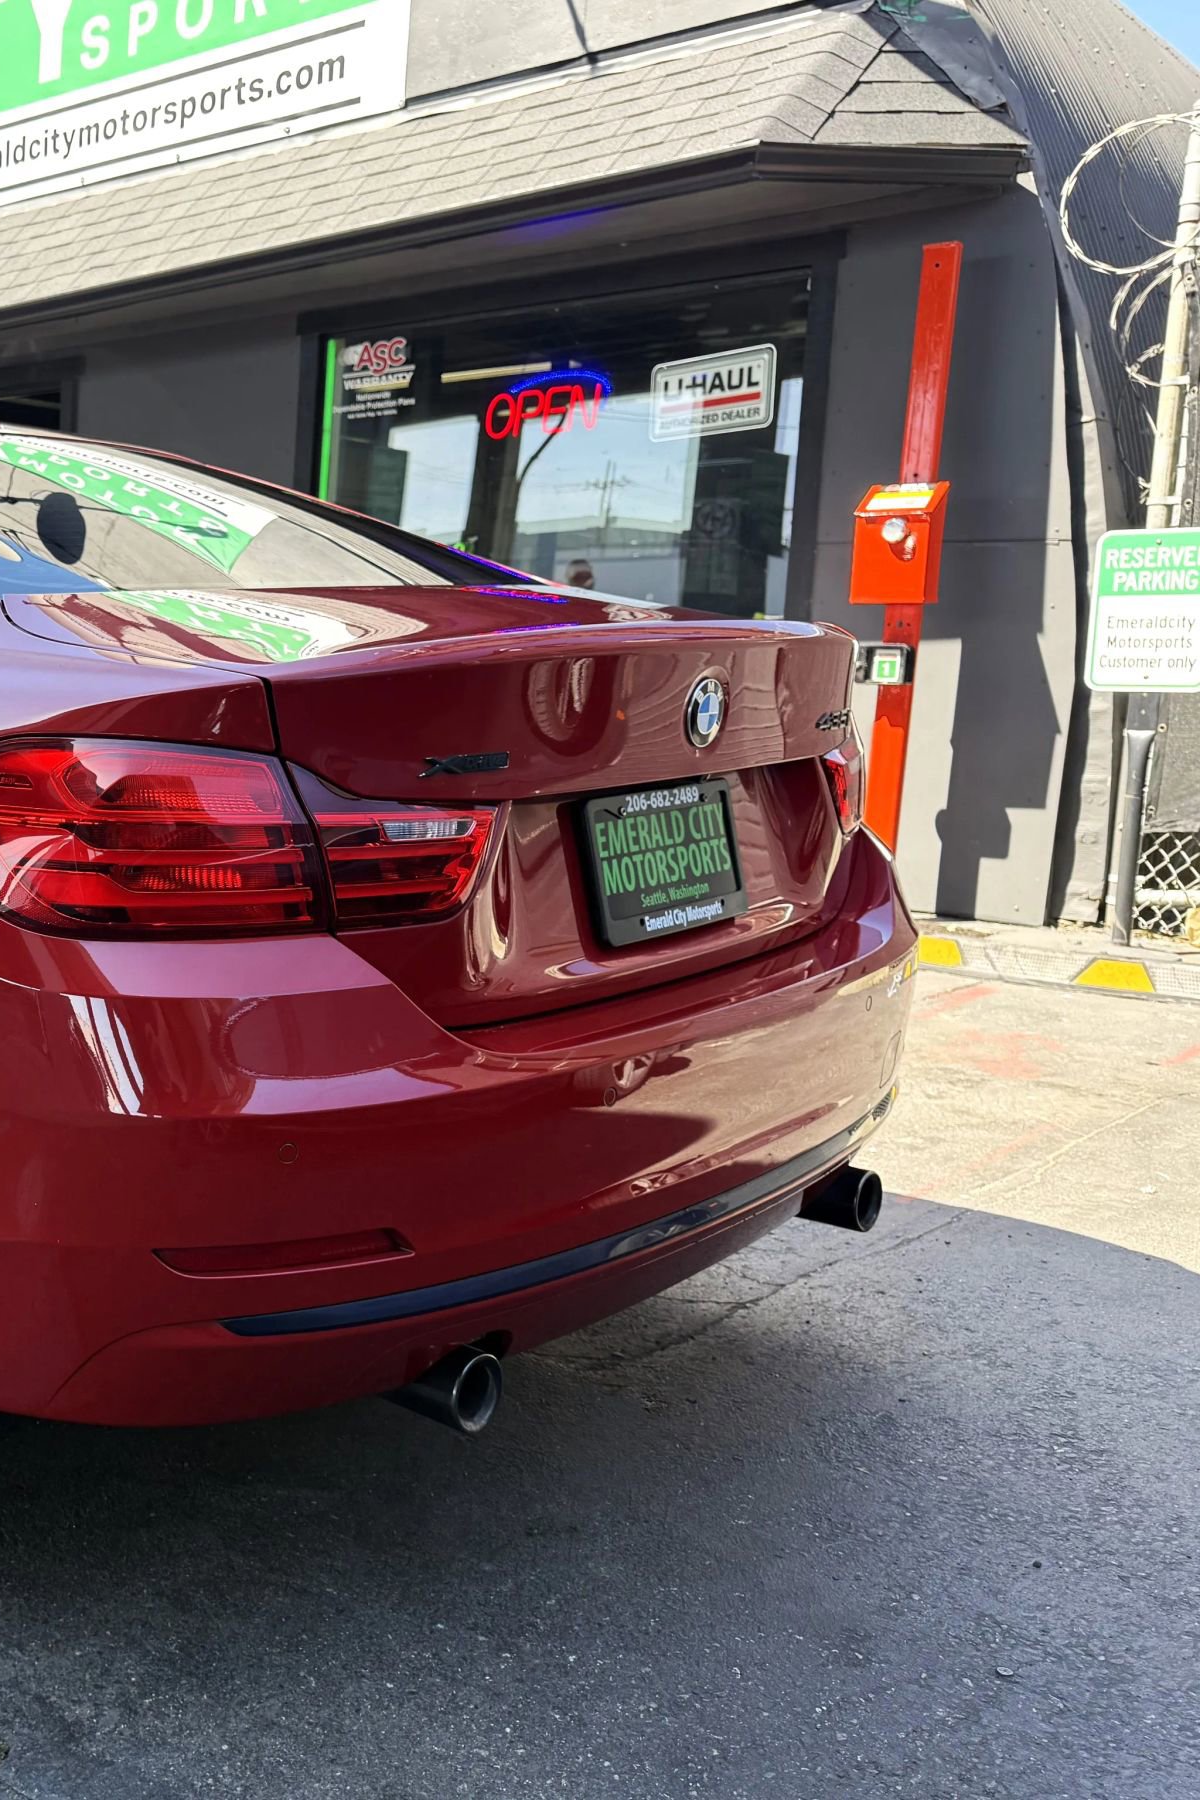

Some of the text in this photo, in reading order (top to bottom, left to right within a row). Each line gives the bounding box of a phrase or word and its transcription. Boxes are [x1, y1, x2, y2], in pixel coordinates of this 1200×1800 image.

[80, 0, 312, 71] SPO
[353, 337, 407, 376] ASC
[663, 366, 760, 402] U-HAUL
[485, 383, 602, 439] OPEN
[721, 407, 760, 421] DEALER
[1105, 545, 1200, 569] RESERVE
[1112, 569, 1199, 592] PARKING
[1107, 615, 1196, 632] Emeraldcity
[1107, 635, 1192, 652] Motorsports
[881, 661, 891, 677] 1
[1099, 654, 1197, 672] Customer only
[695, 681, 724, 703] BMW
[625, 786, 699, 813] 206-682-2489
[595, 800, 725, 859] EMERALD CITY
[601, 837, 731, 897] MOTORSPORTS
[640, 882, 710, 908] Seattle, Washington
[644, 899, 723, 932] Emerald City Motorsports
